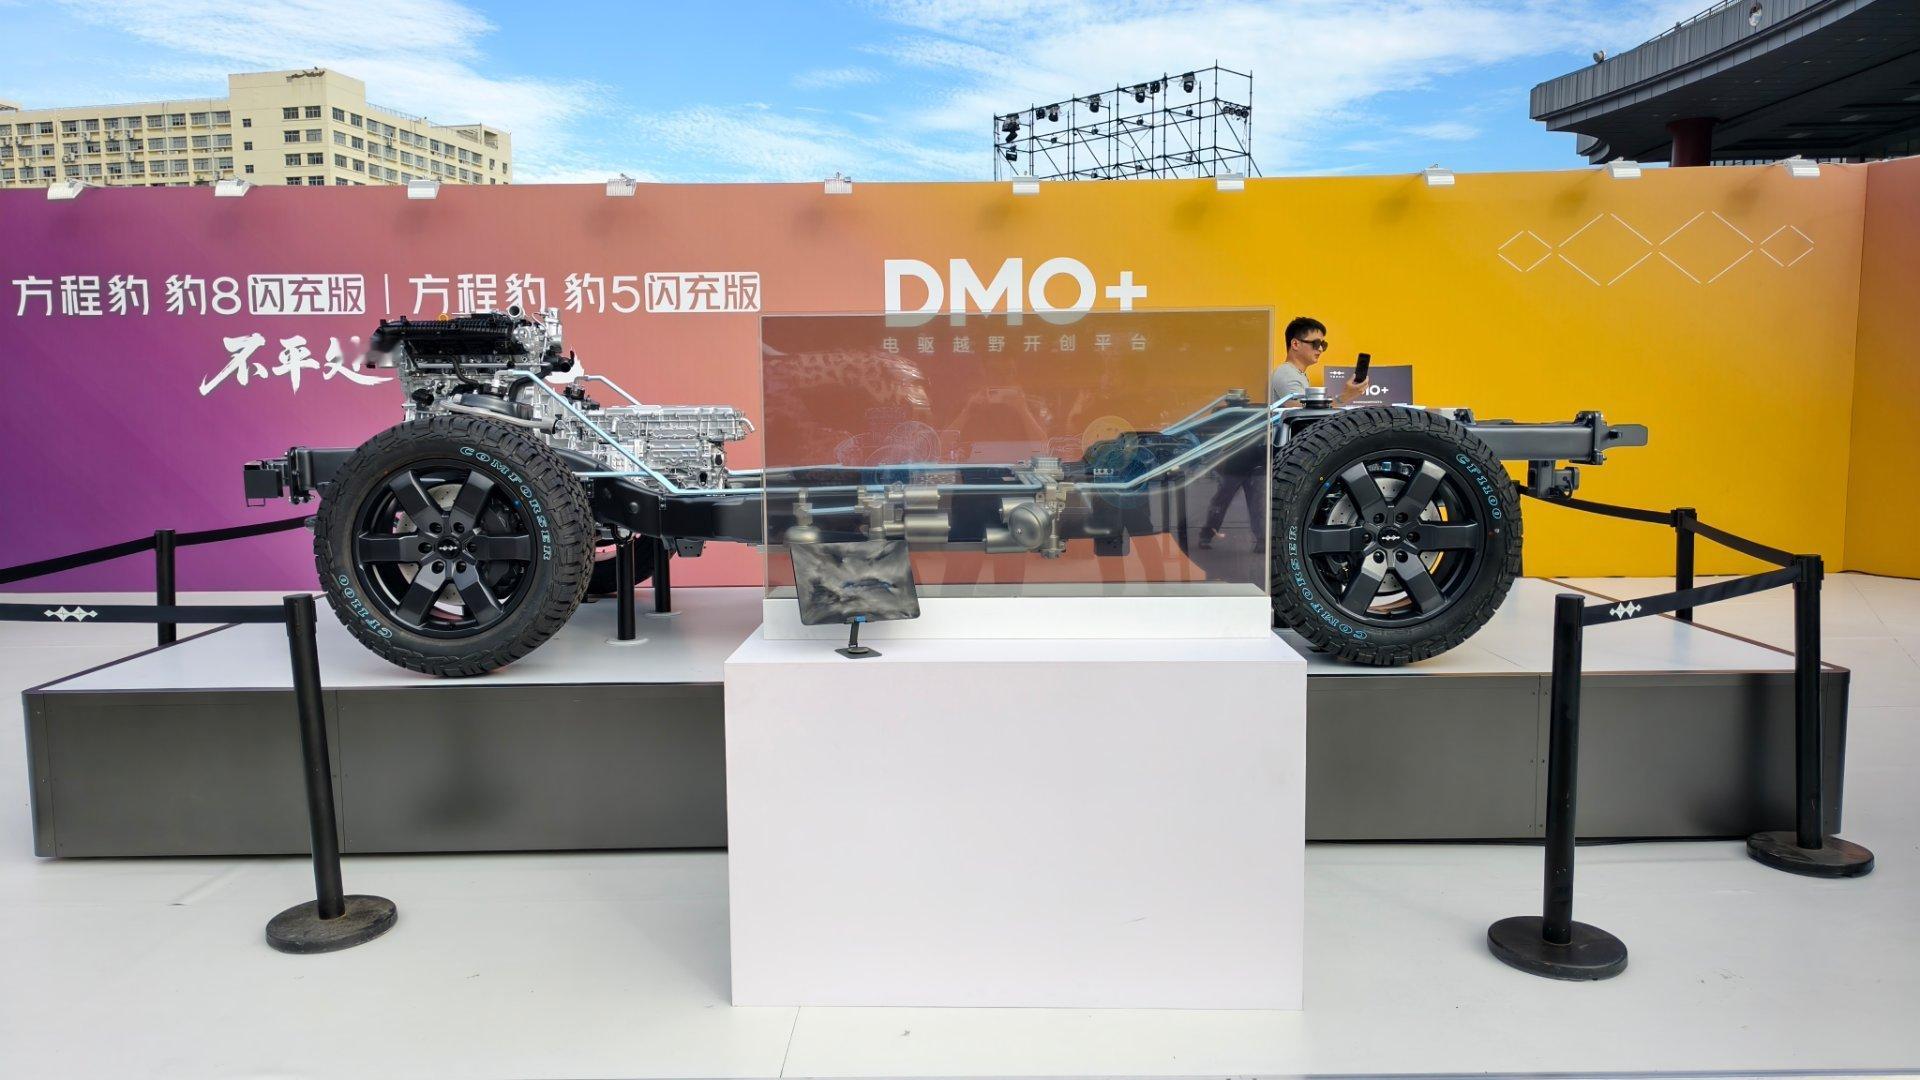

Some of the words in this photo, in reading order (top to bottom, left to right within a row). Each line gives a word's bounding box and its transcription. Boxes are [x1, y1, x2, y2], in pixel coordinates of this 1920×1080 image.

[12, 274, 150, 316] 方程豹
[409, 273, 546, 315] 方程豹
[884, 256, 1147, 327] DMO+
[882, 334, 1147, 354] 电驱越野开创平台
[459, 446, 551, 562] COMFORSER
[1288, 525, 1368, 641] COMFORSER
